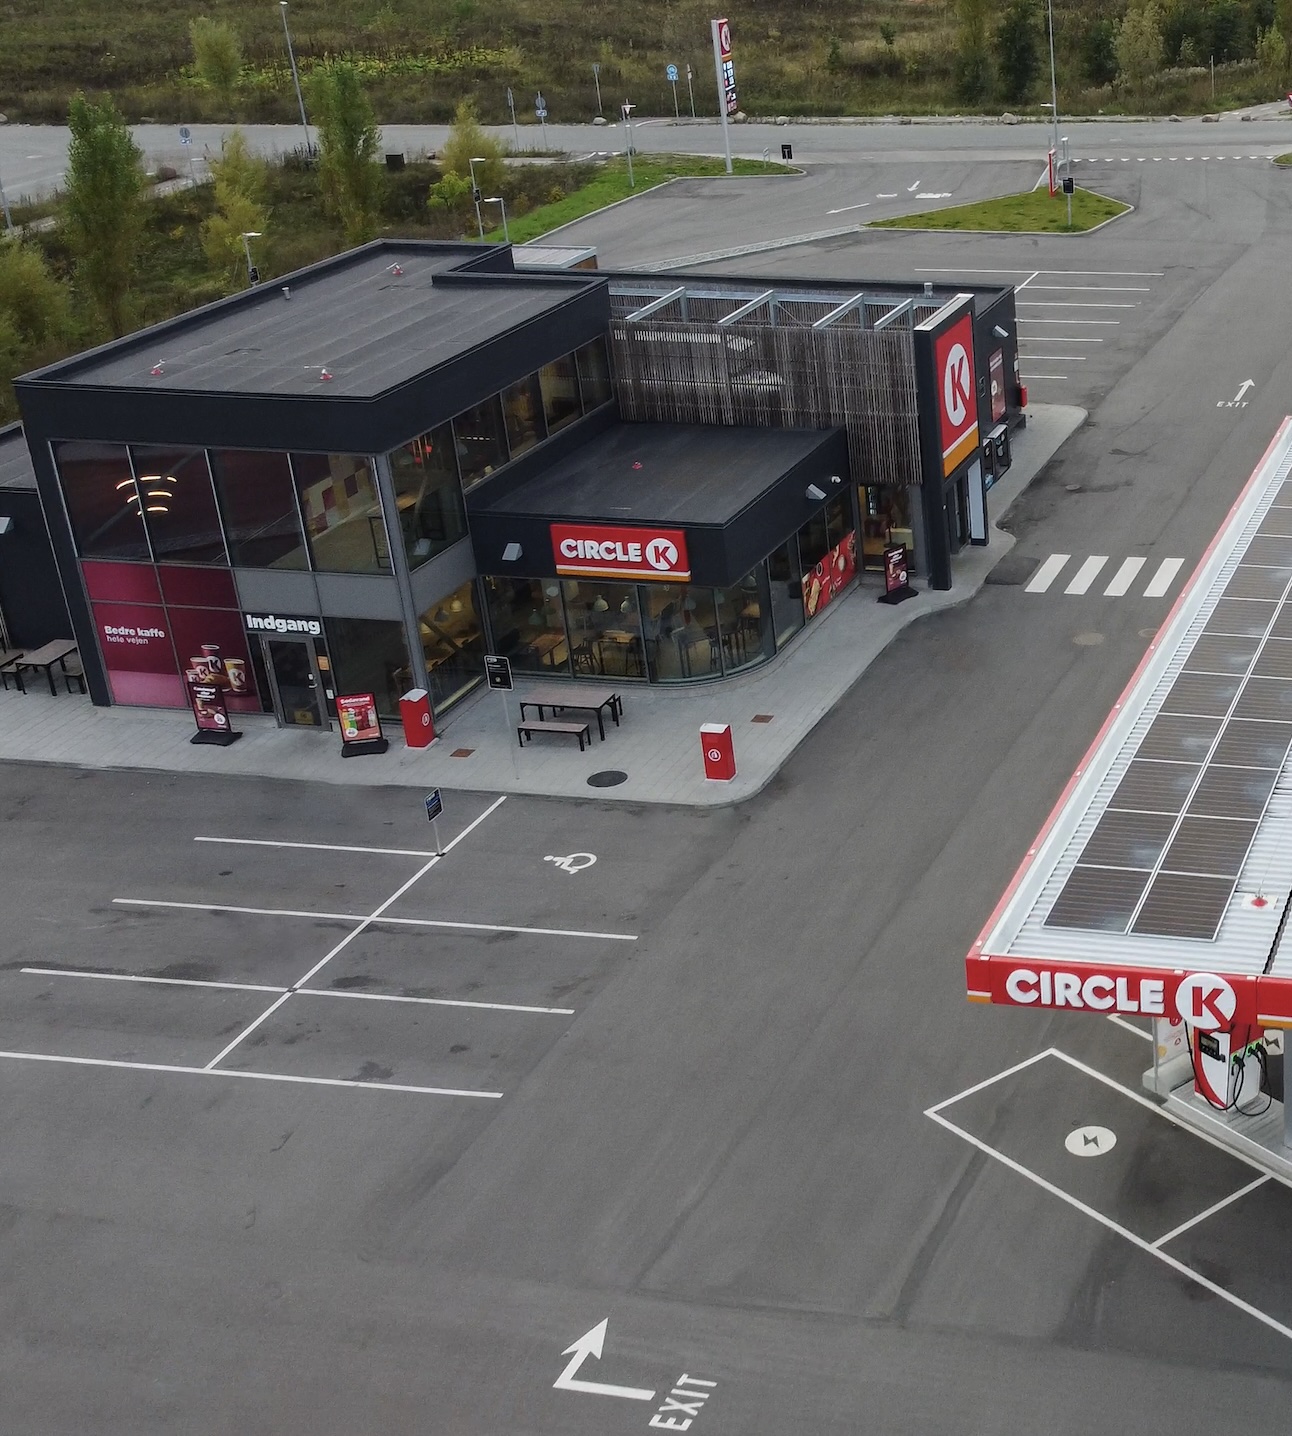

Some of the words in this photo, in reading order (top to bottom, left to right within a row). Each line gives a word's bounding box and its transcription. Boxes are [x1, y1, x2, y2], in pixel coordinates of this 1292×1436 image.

[949, 352, 969, 414] K
[560, 538, 643, 562] CIRCLE
[651, 543, 677, 569] K
[104, 625, 136, 636] Bedre
[136, 627, 165, 638] kaffe
[106, 635, 125, 643] hele
[126, 636, 149, 645] vejen
[246, 614, 321, 636] Indgang
[1005, 968, 1165, 1014] CIRCLE
[1190, 983, 1231, 1029] K
[649, 1373, 718, 1431] EXIT
